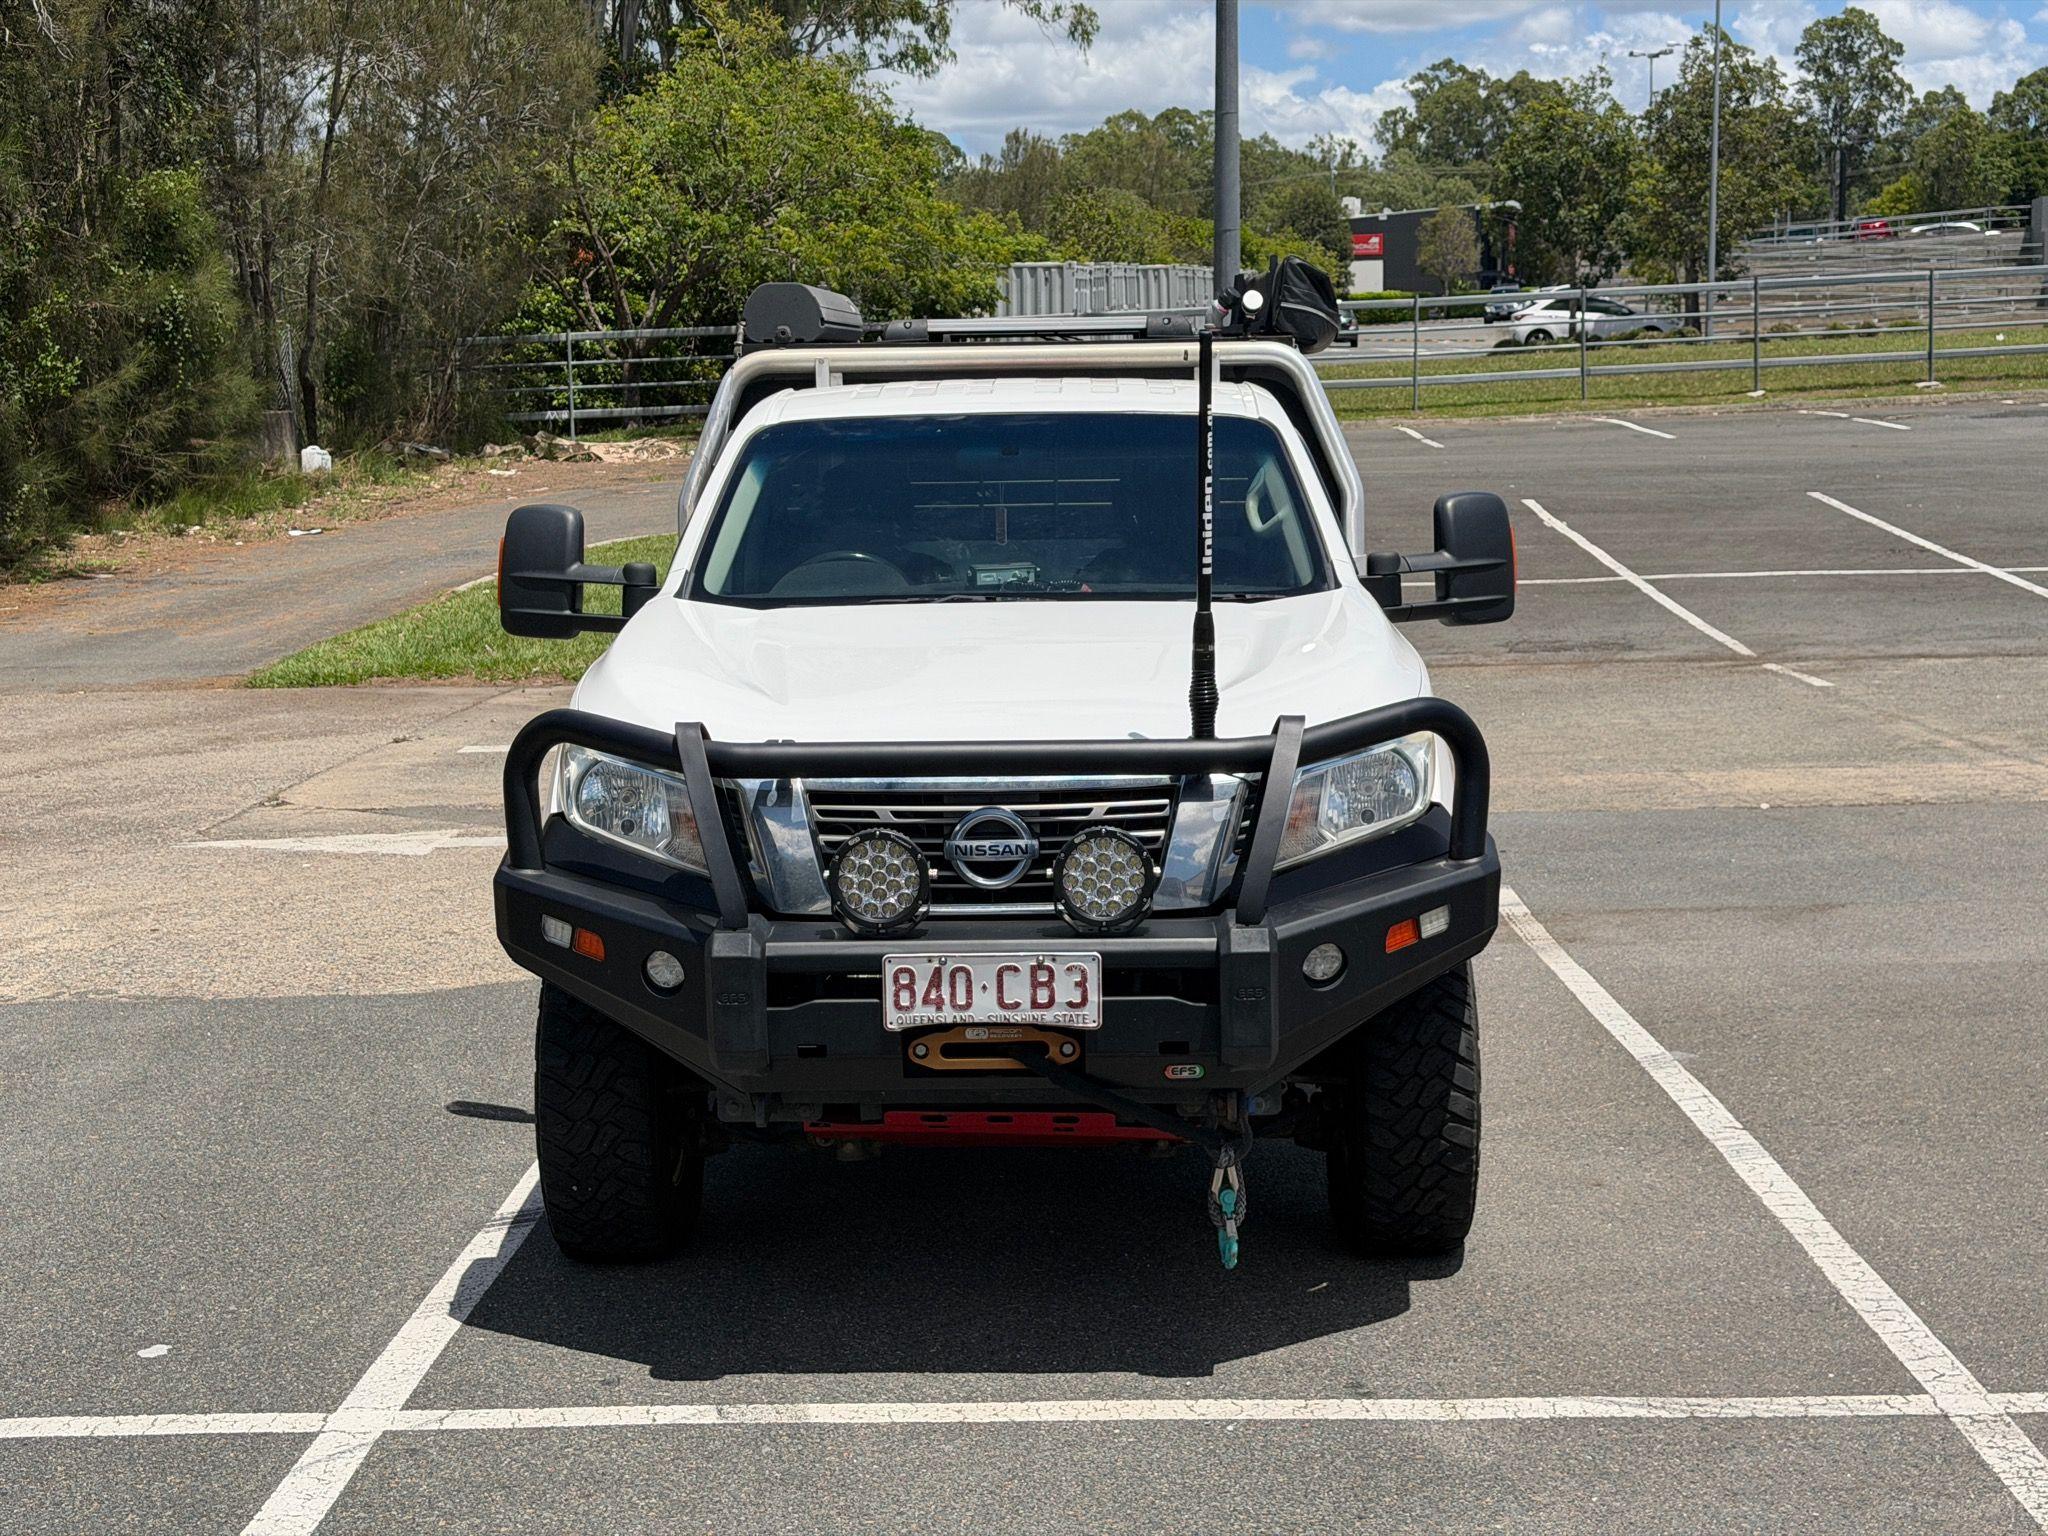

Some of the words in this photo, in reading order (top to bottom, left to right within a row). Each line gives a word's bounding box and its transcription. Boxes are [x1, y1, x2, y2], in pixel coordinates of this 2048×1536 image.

[954, 843, 1029, 857] NISSAN
[896, 1012, 975, 1025] QUEENSLAND
[986, 1012, 1048, 1024] SUNSHINE
[1053, 1012, 1090, 1025] STATE
[1171, 1066, 1198, 1076] EFS
